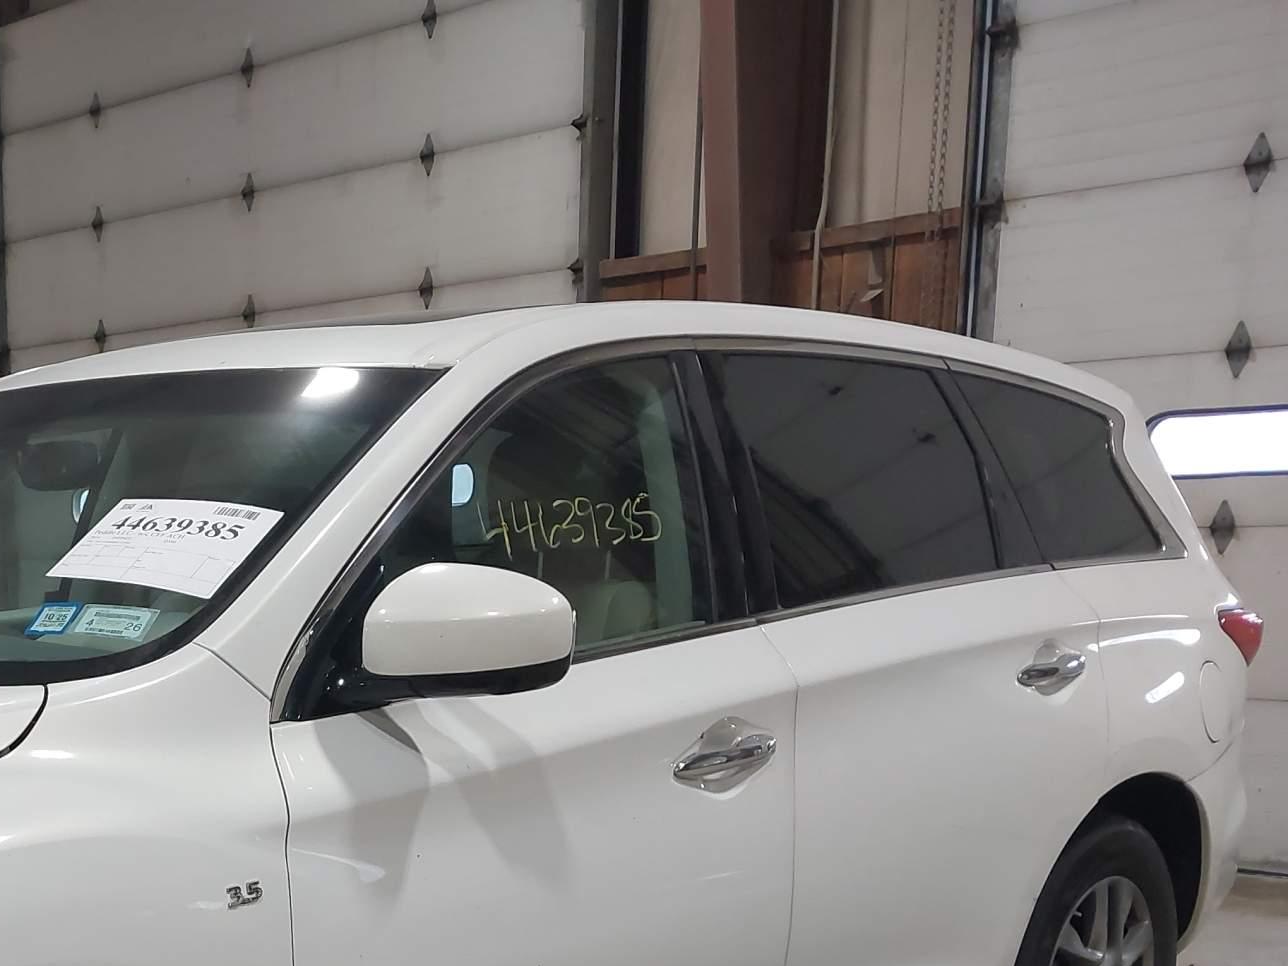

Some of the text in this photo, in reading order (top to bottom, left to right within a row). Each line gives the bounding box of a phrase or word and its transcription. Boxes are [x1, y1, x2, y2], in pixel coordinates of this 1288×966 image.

[112, 515, 246, 541] 44639385
[476, 492, 662, 561] 44639385
[123, 622, 143, 632] 26
